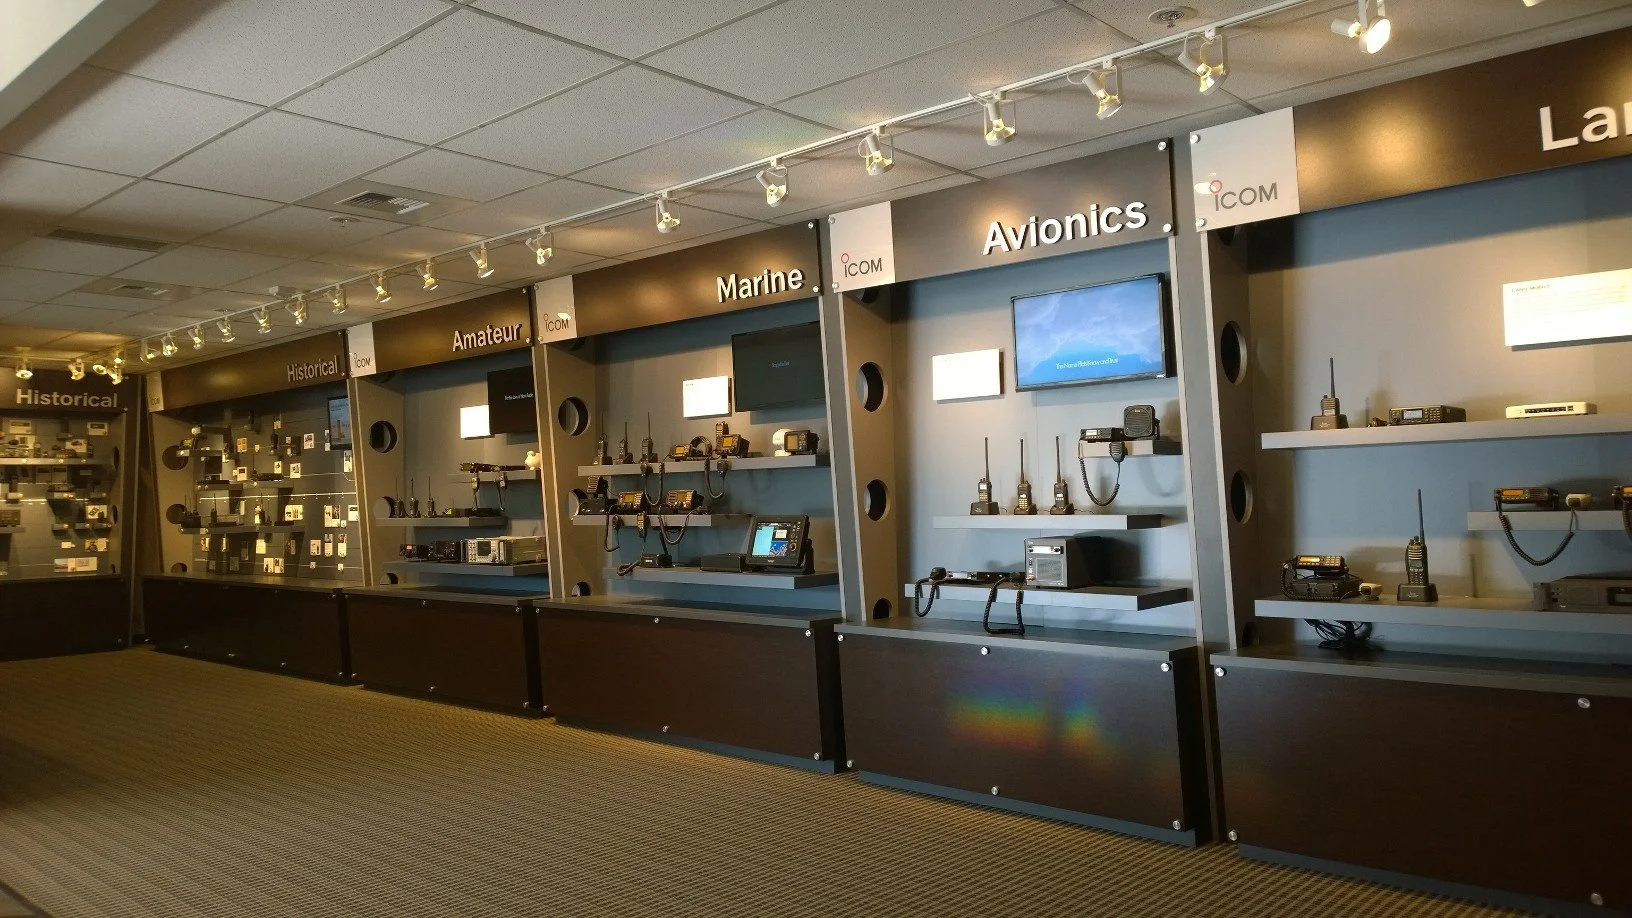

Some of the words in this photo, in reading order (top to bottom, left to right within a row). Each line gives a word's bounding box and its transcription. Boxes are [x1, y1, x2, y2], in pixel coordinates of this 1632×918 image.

[982, 200, 1148, 256] Avionics
[716, 268, 803, 303] Marine
[452, 323, 522, 352] Amateur
[286, 355, 339, 382] Historical
[16, 388, 118, 408] Historical
